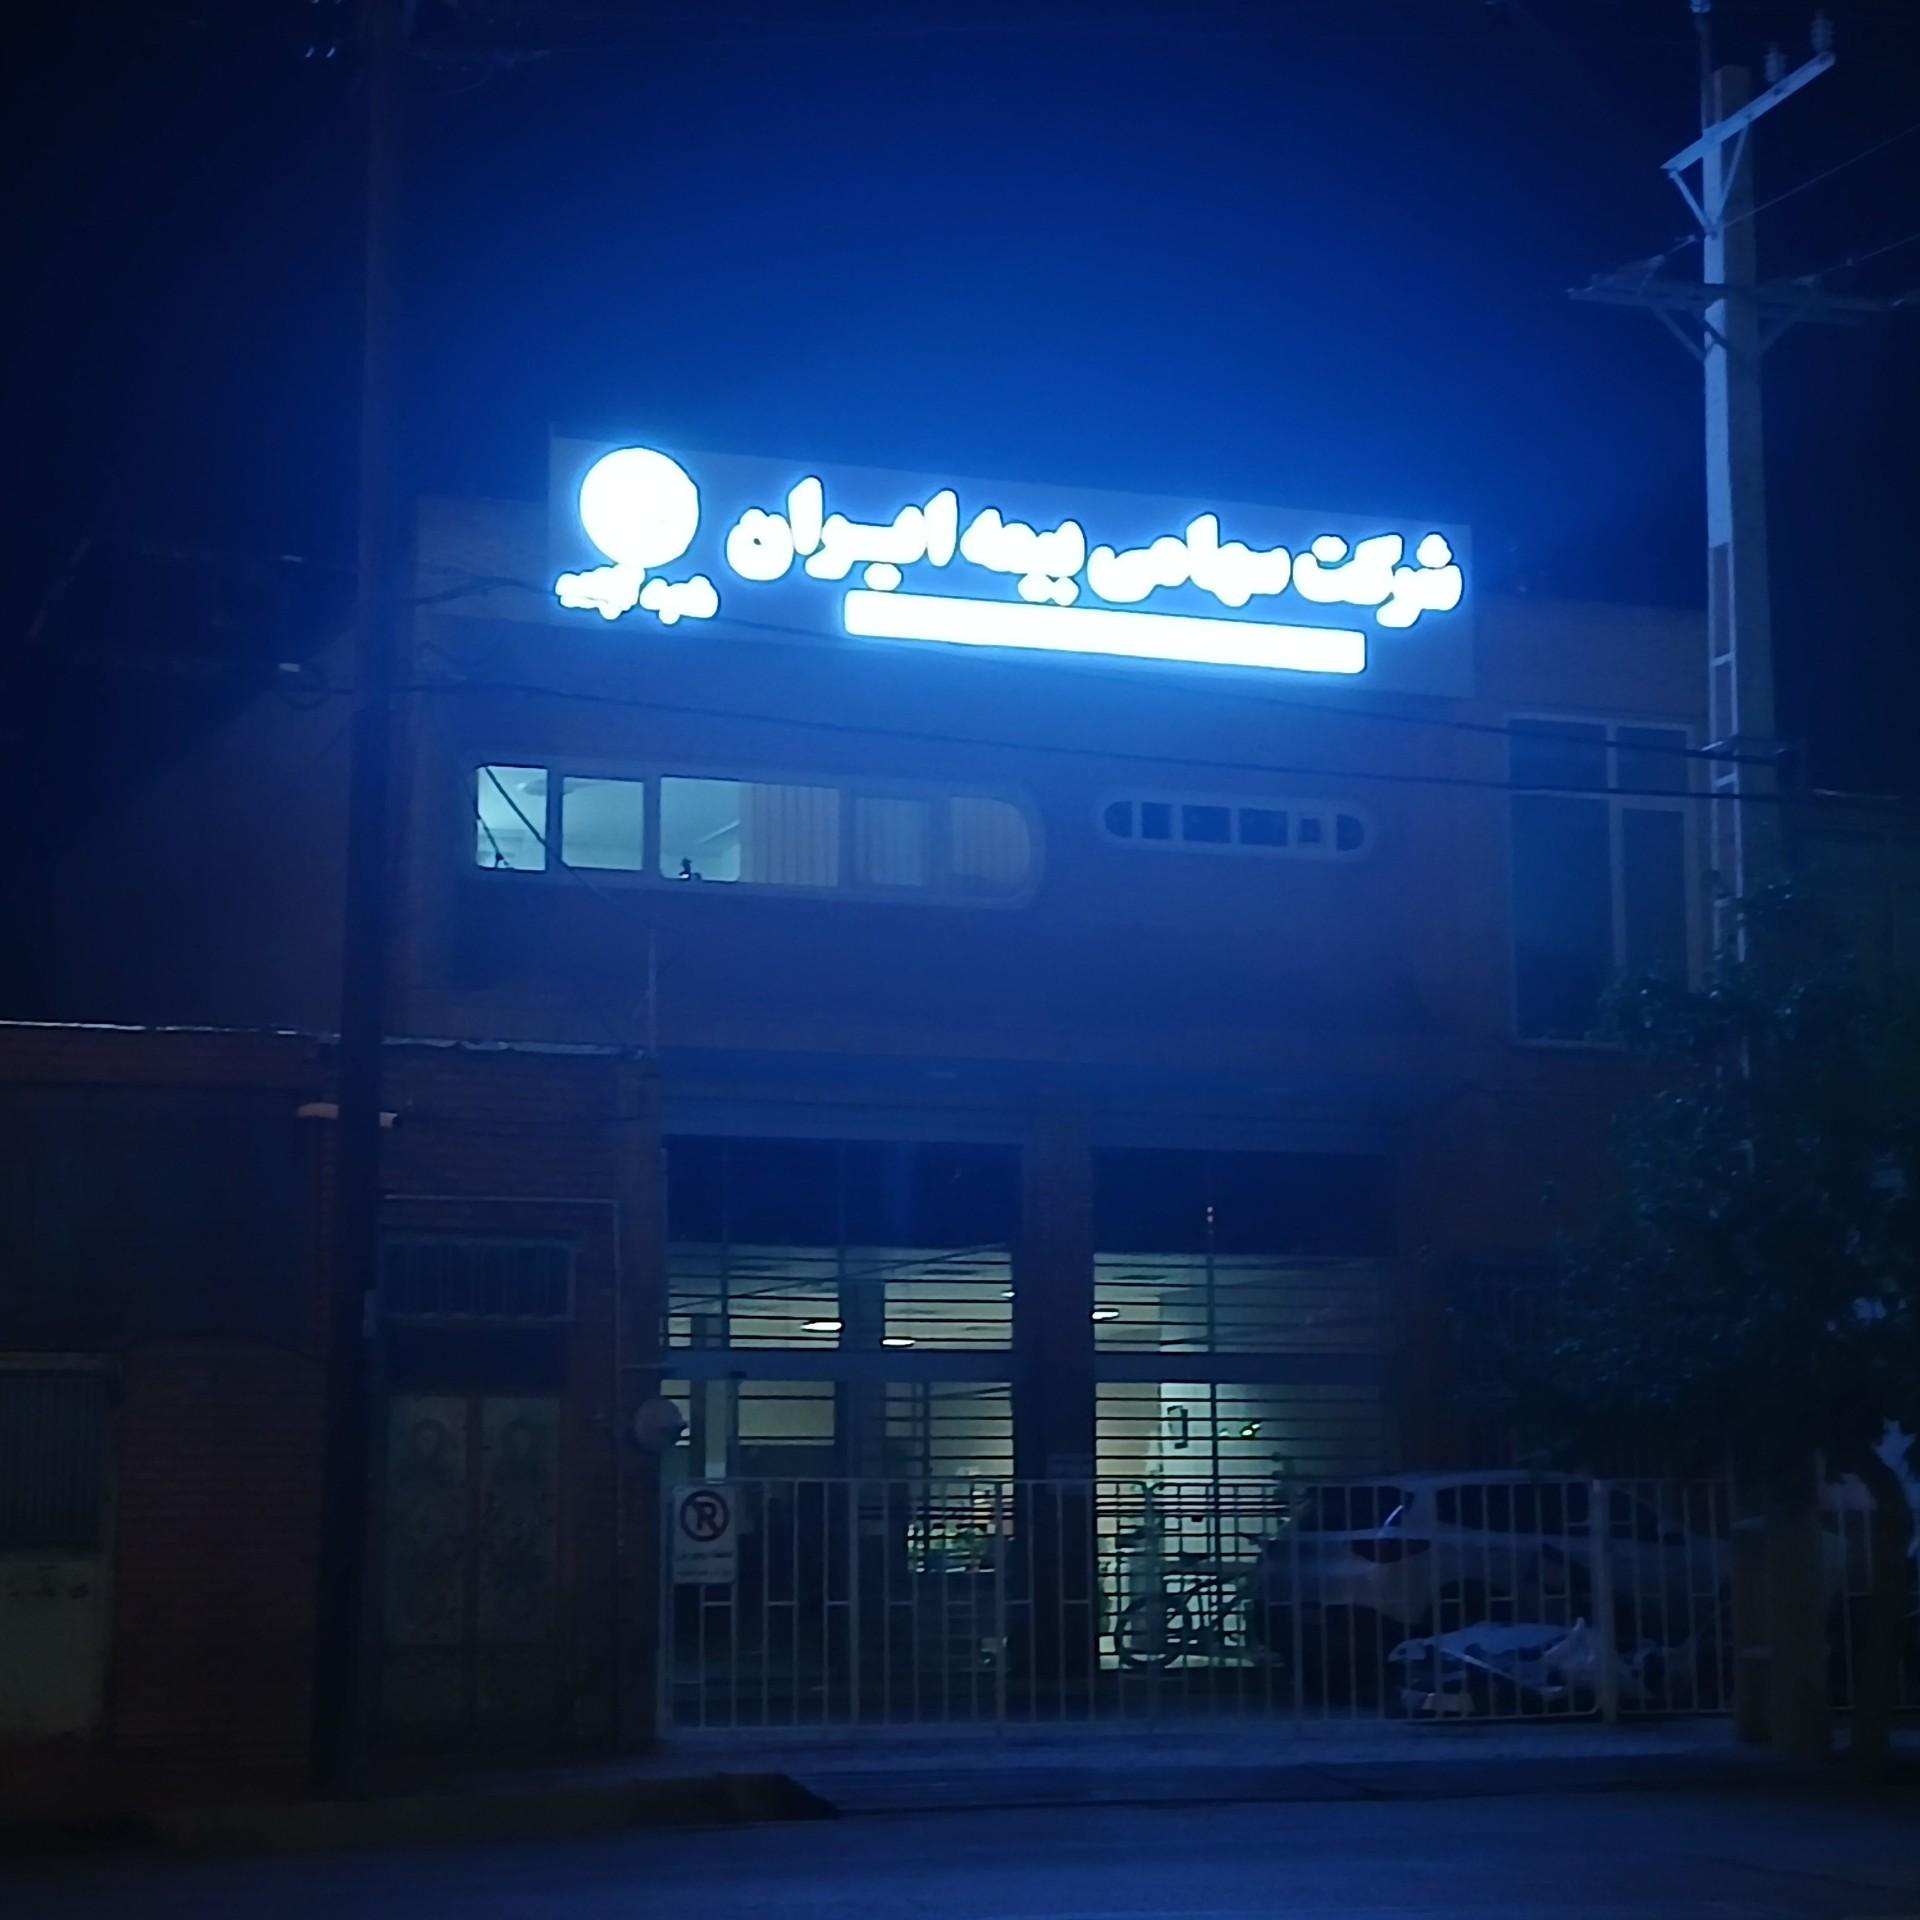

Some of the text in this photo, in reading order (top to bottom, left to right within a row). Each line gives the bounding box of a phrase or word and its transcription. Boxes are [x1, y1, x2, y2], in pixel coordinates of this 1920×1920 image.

[726, 476, 1464, 629] شرکت سهامی بیمه ایران
